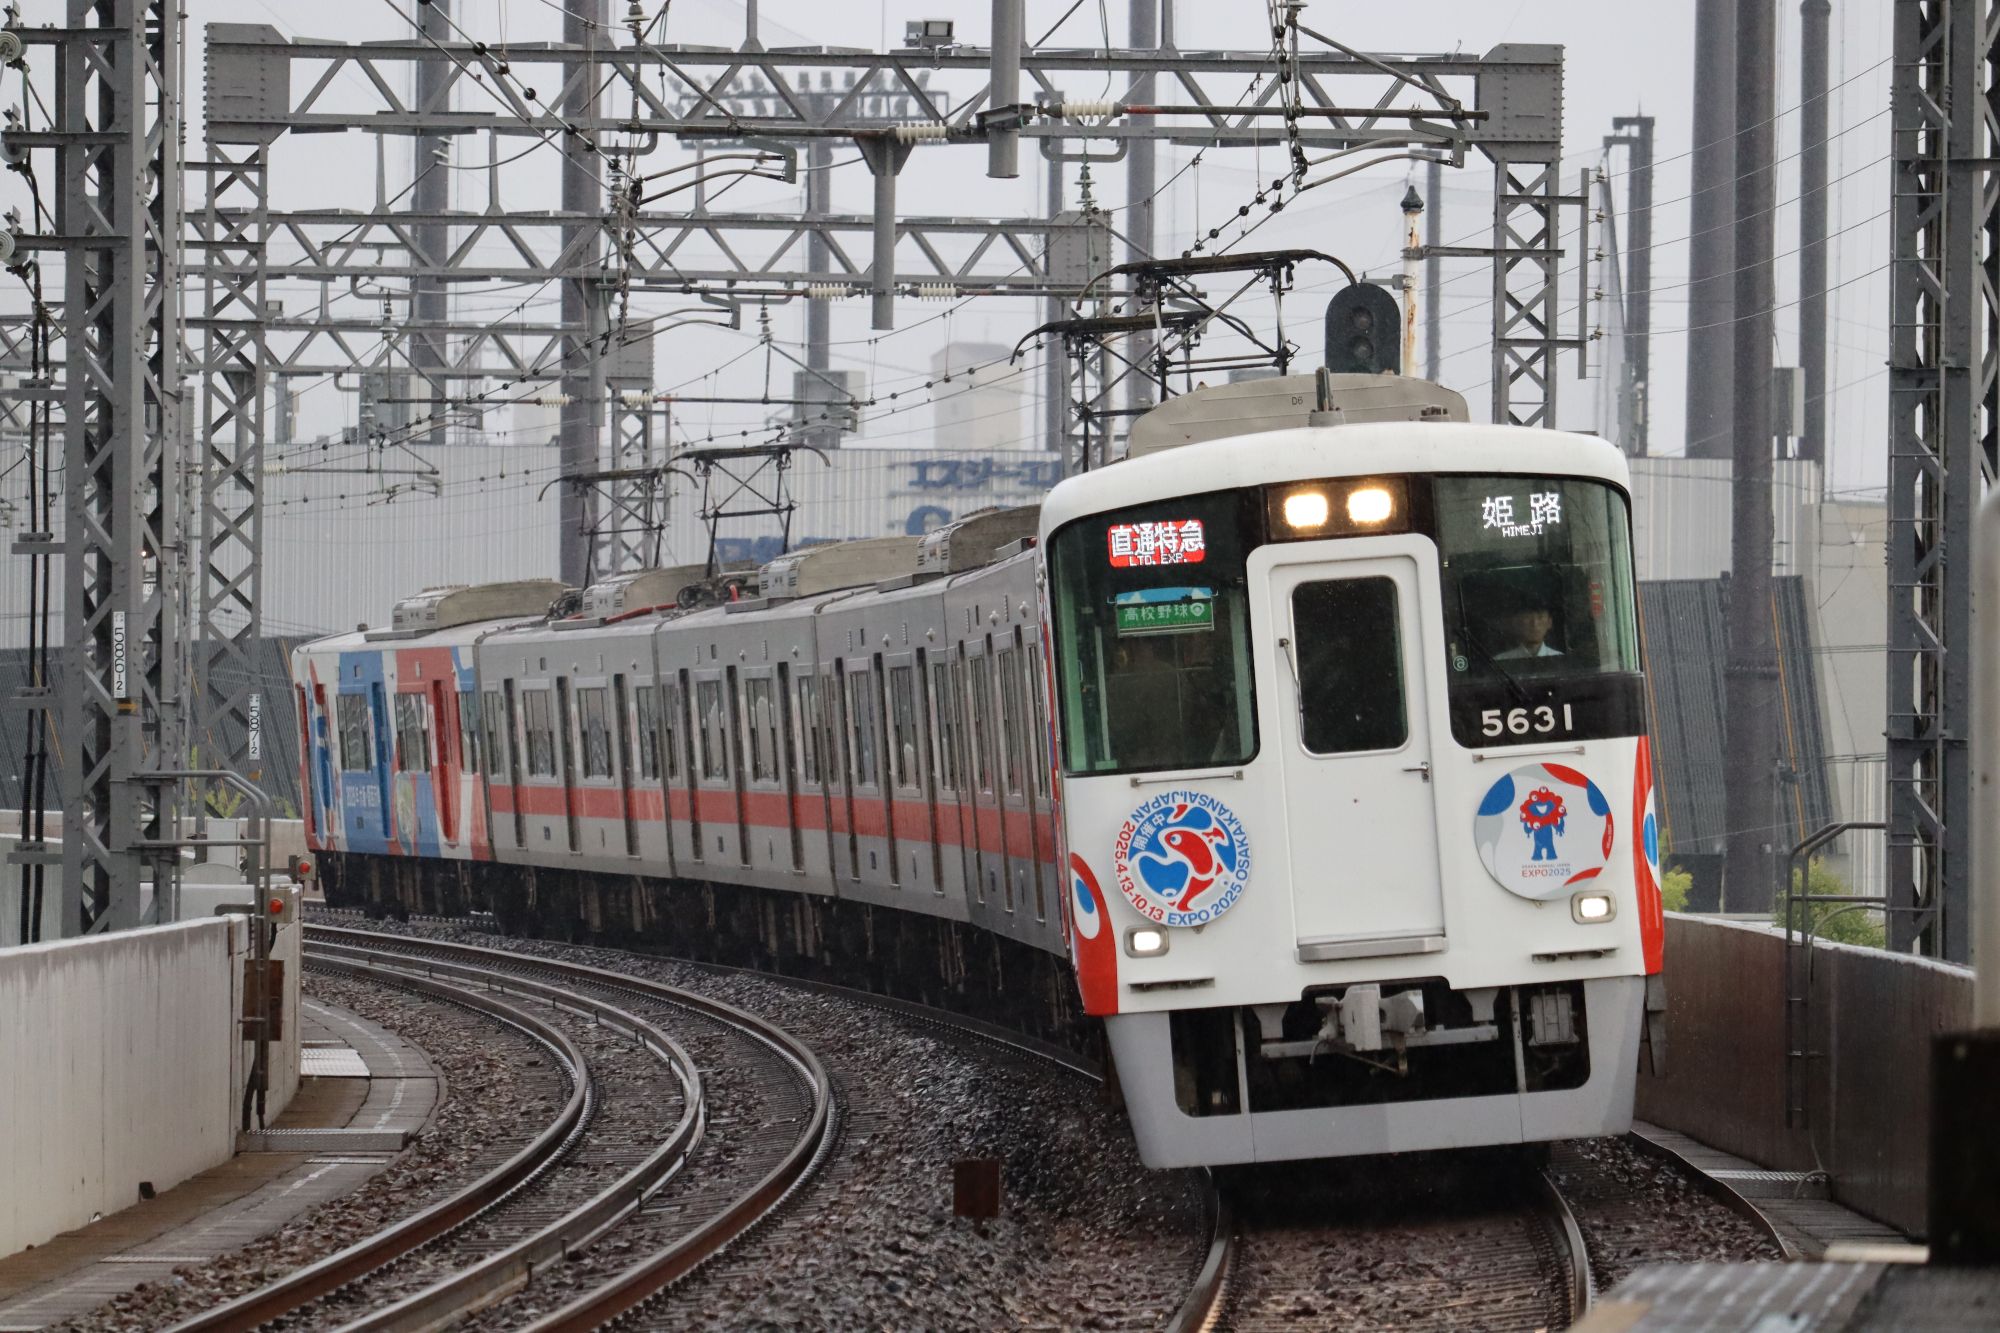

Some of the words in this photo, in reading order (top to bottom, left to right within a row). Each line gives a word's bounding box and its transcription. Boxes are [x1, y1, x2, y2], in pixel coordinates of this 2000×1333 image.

[1481, 492, 1562, 529] 姫路
[1110, 520, 1205, 558] 直通特急
[1501, 524, 1543, 538] HIMEJI
[1128, 555, 1157, 567] LTD.
[1160, 552, 1188, 565] EXP.
[1124, 604, 1188, 622] 高校野球
[1481, 703, 1573, 737] 5631
[1132, 813, 1166, 851] 開催中
[1114, 820, 1164, 921] 2025.4.13-10.13
[1521, 867, 1571, 878] EXPO2025
[1167, 909, 1210, 926] EXPO
[1210, 881, 1243, 916] 2025
